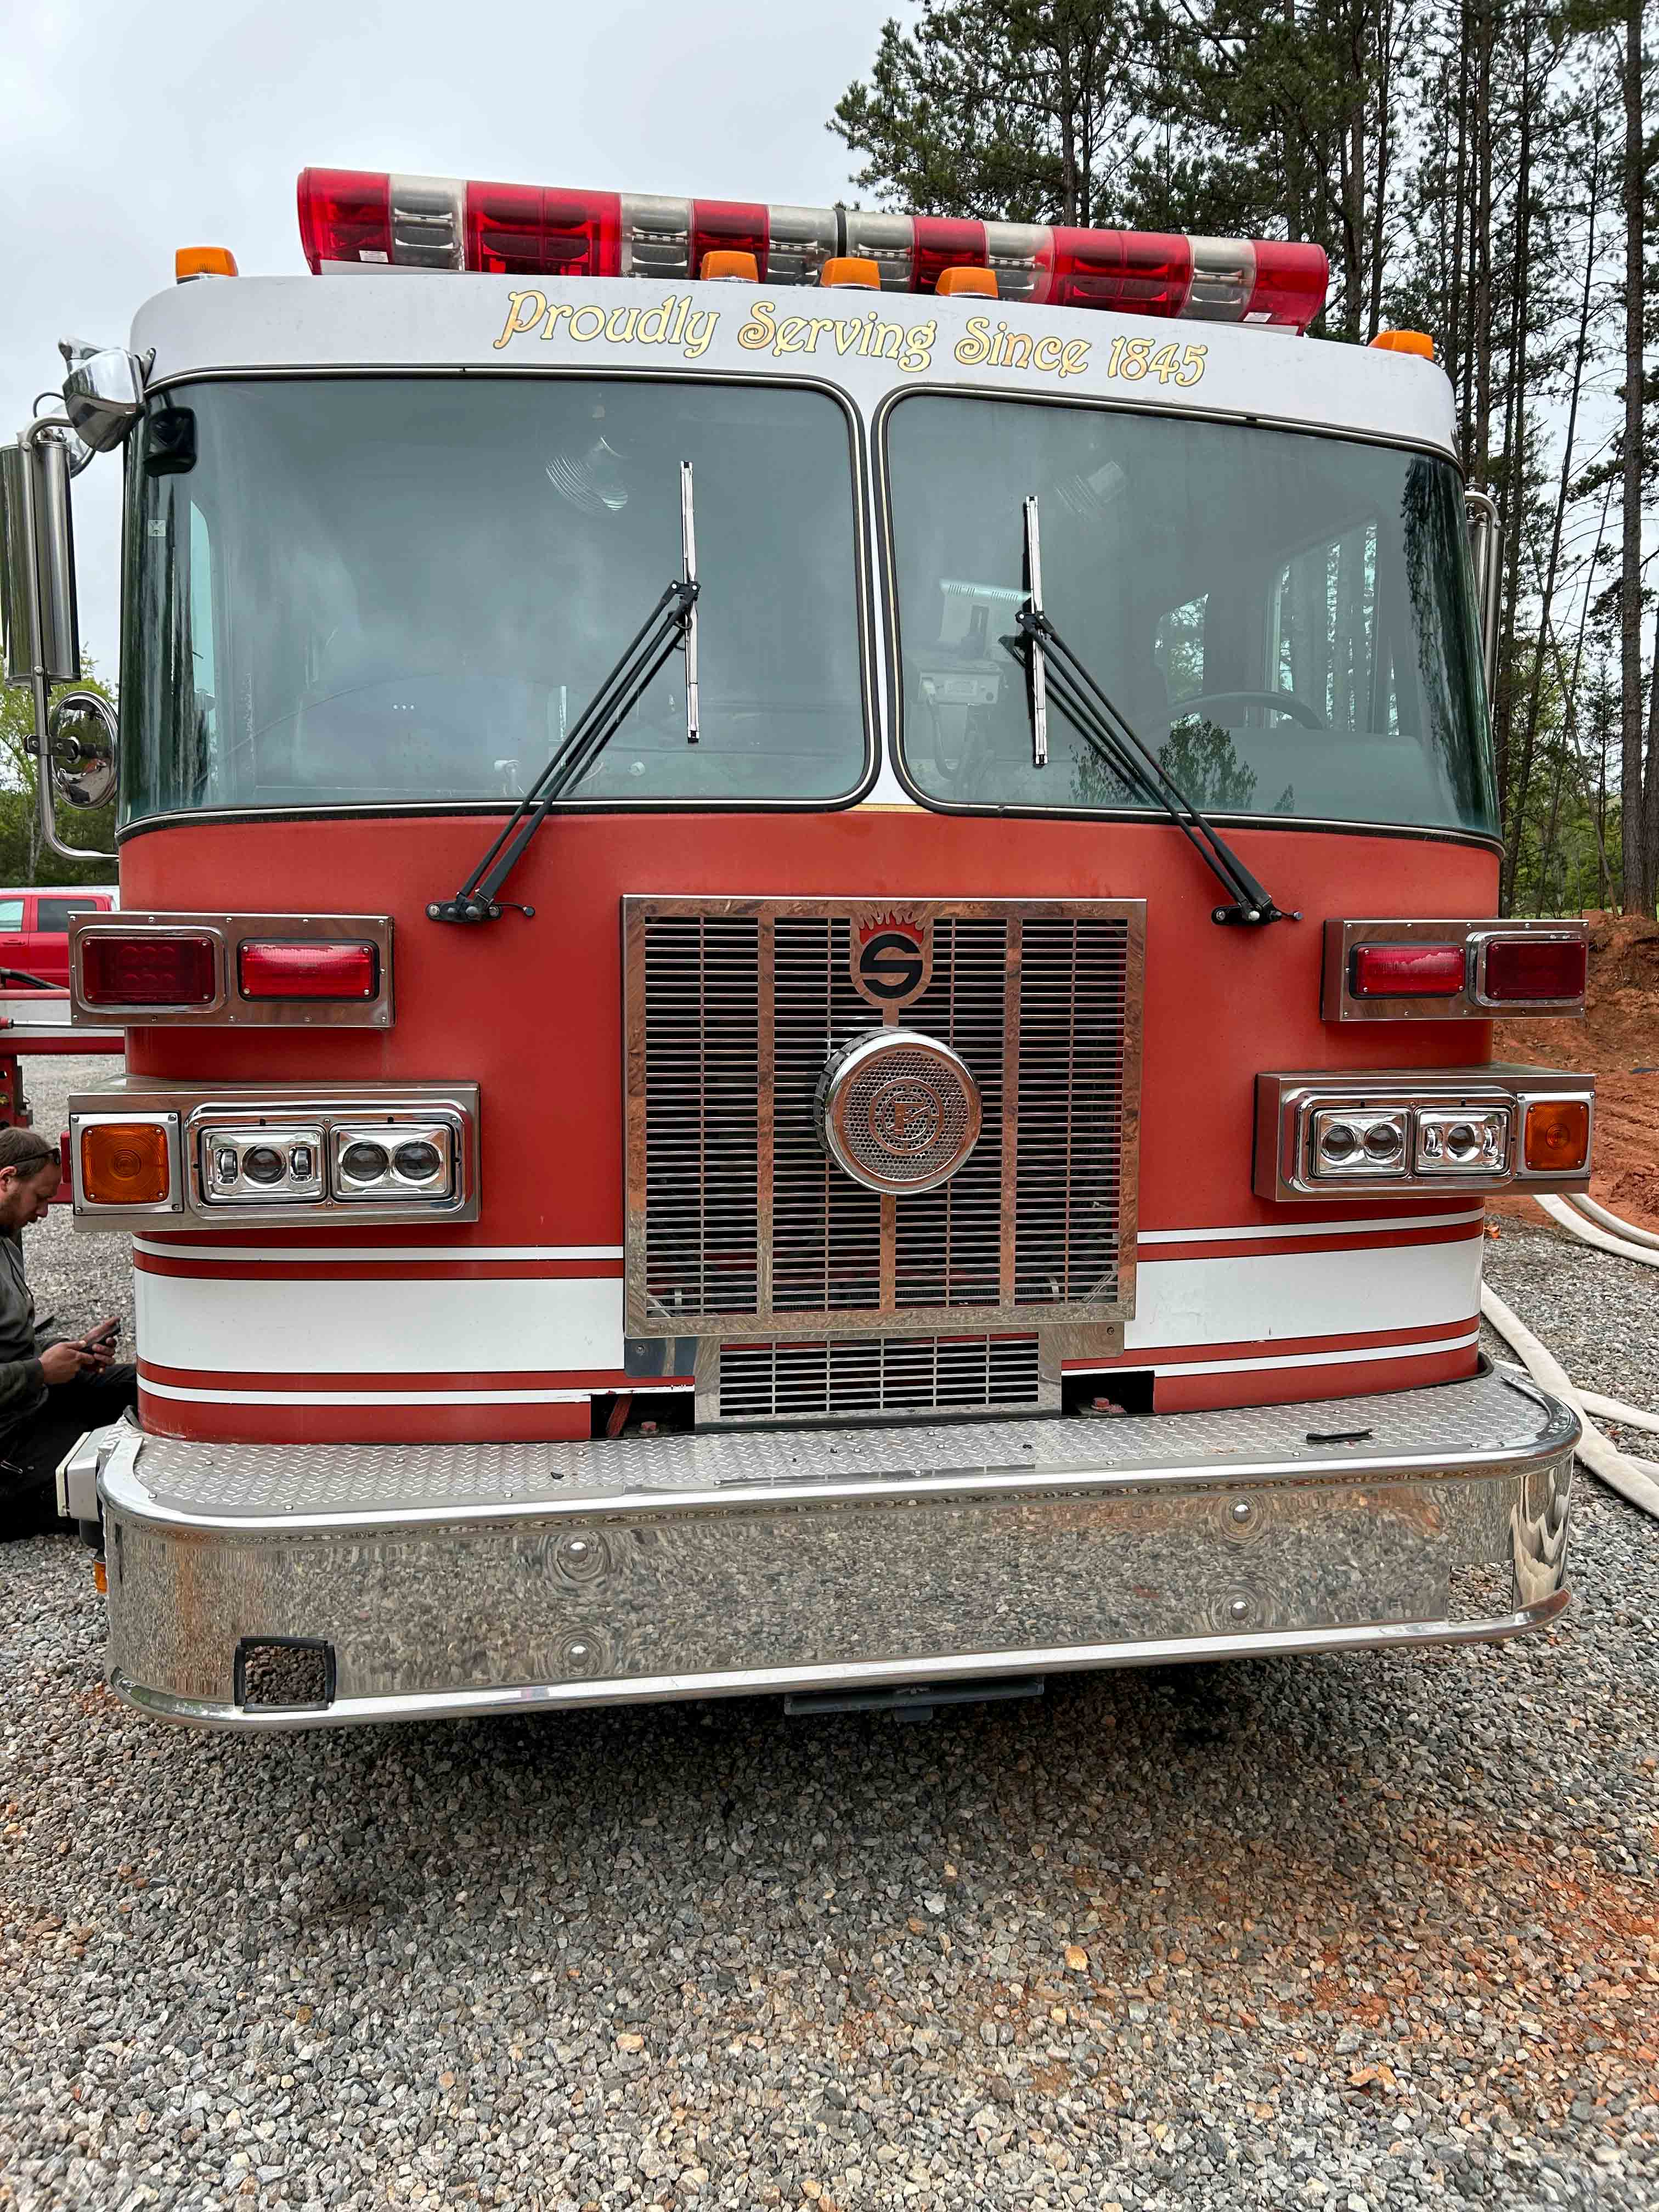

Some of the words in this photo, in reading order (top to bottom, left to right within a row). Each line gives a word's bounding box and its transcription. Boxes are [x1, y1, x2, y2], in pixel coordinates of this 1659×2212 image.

[493, 290, 720, 358] Proudly
[737, 301, 936, 373] Serving
[953, 317, 1092, 378] Since
[1108, 336, 1208, 387] 1845
[860, 934, 923, 999] S
